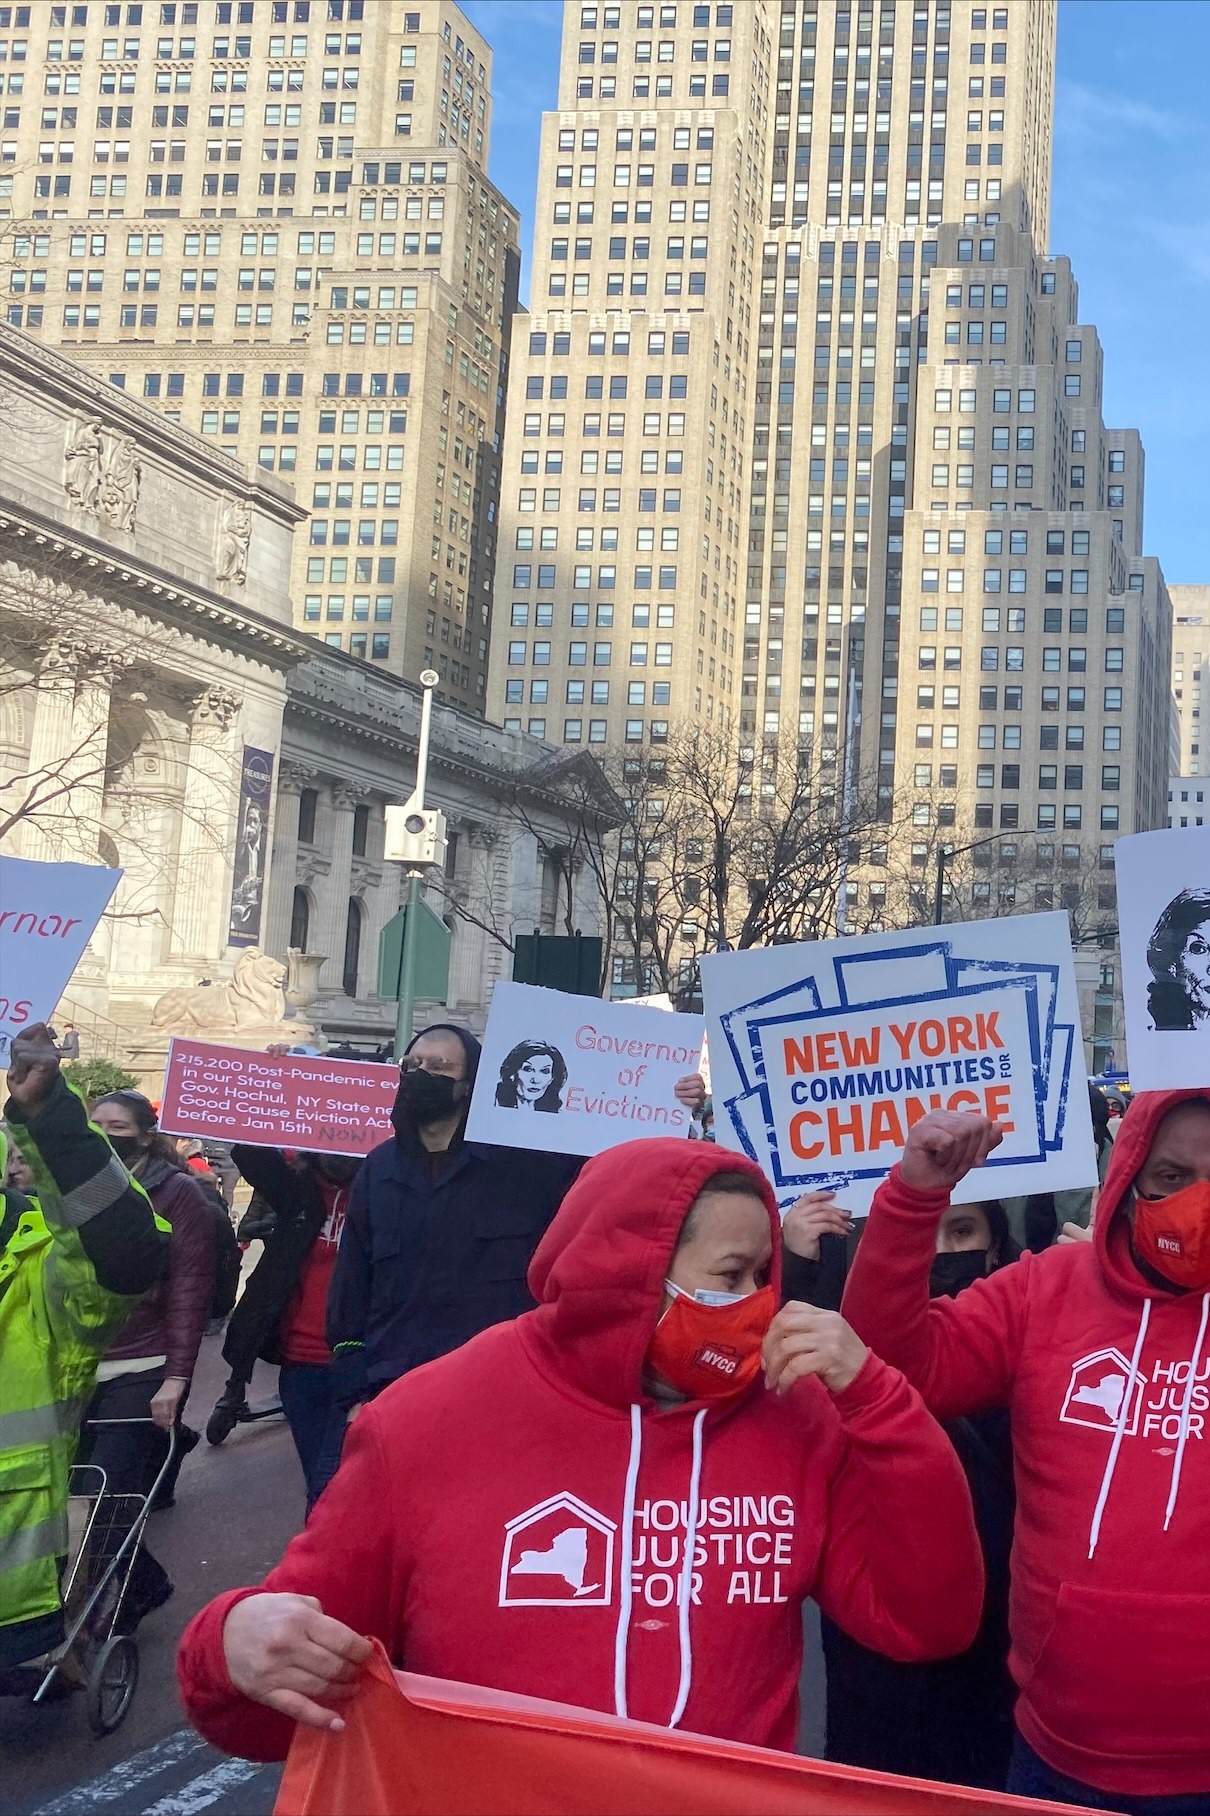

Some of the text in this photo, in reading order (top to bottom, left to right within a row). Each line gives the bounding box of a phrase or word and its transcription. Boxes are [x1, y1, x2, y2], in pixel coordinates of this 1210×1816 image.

[575, 1025, 700, 1065] Governor
[783, 1011, 1005, 1076] NEW YORK
[183, 1066, 283, 1090] in our State
[248, 1063, 376, 1088] Post-Pandemic
[617, 1064, 648, 1087] of
[790, 1052, 1011, 1105] COMMUNITIES FOR
[179, 1093, 393, 1129] Good Cause Eviction Act
[181, 1080, 219, 1095] Gov.
[224, 1086, 288, 1105] Hochul.
[297, 1095, 321, 1108] NY
[326, 1098, 371, 1113] State
[565, 1087, 684, 1127] Evictions
[176, 1107, 313, 1135] before Jan 15th
[1157, 1237, 1181, 1253] NYCC
[701, 1350, 736, 1374] NYCC
[1142, 1413, 1205, 1440] FOR
[632, 1494, 795, 1532] HOUSING
[631, 1531, 794, 1568] JUSTICE
[631, 1570, 789, 1608] FOR ALL
